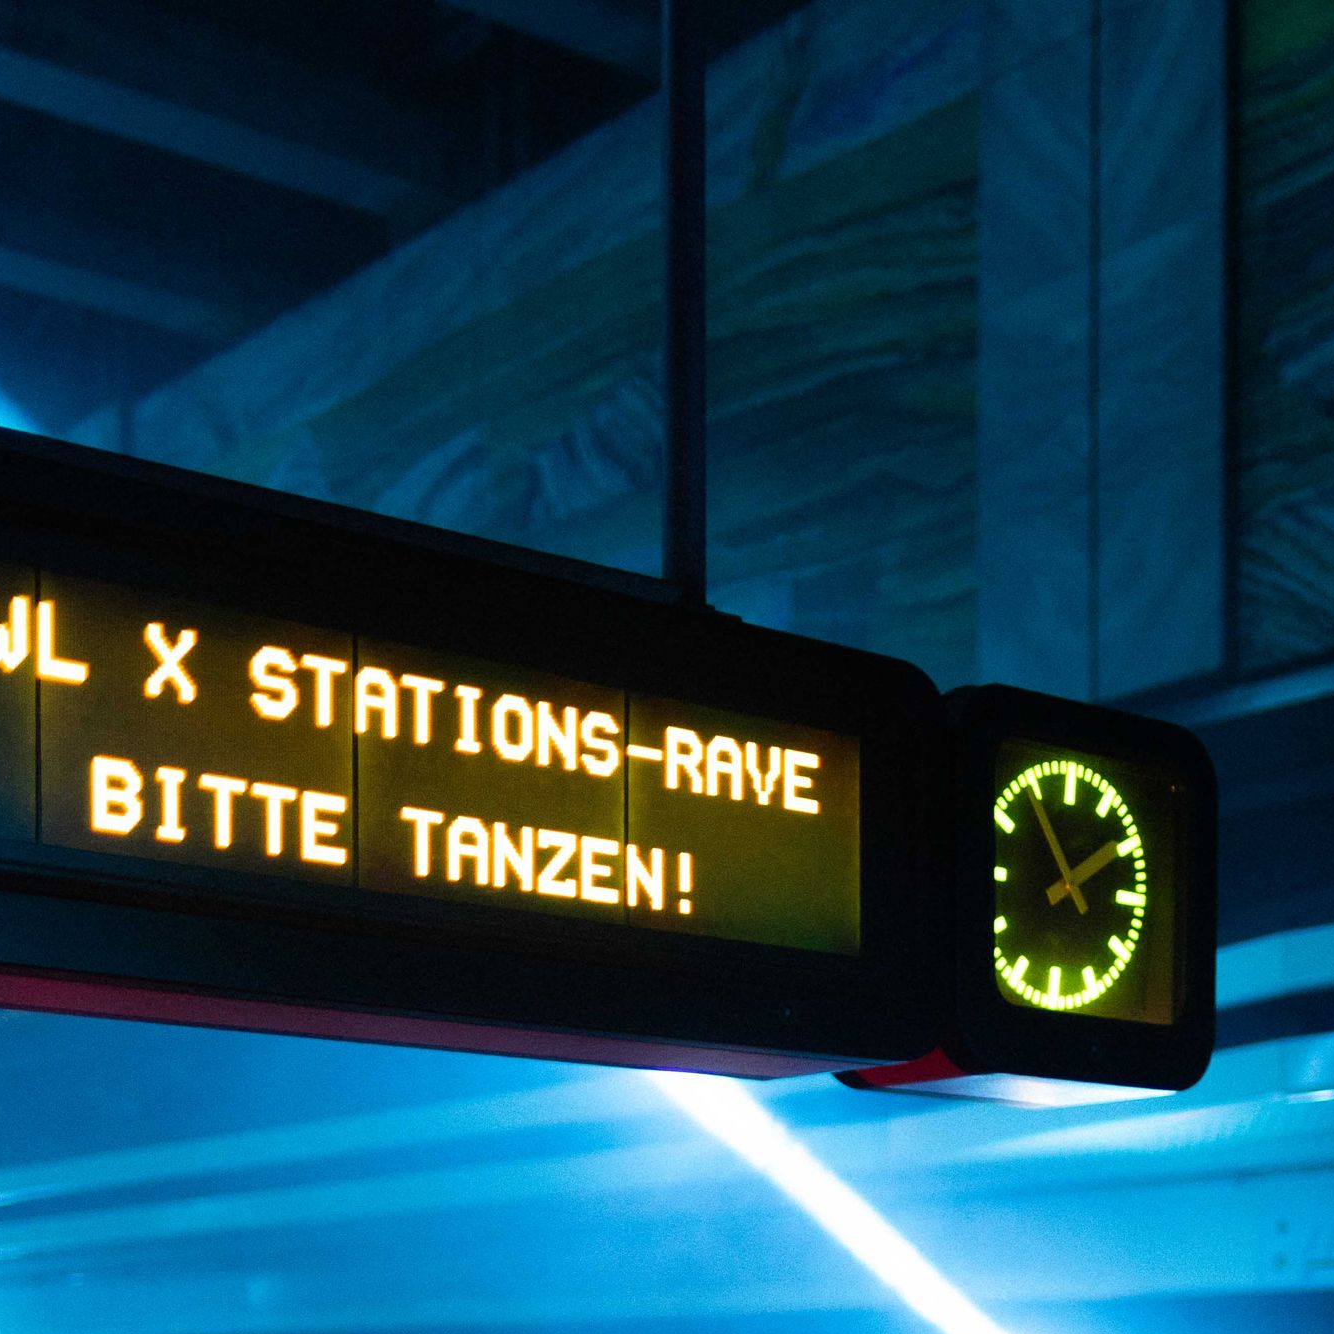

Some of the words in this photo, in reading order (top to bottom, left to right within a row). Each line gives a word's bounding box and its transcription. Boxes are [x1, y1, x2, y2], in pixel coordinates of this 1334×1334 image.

[143, 622, 197, 705] X
[249, 645, 821, 815] STATIONS-RAVE
[89, 755, 349, 866] BITTE
[400, 806, 694, 915] TANZEN!
